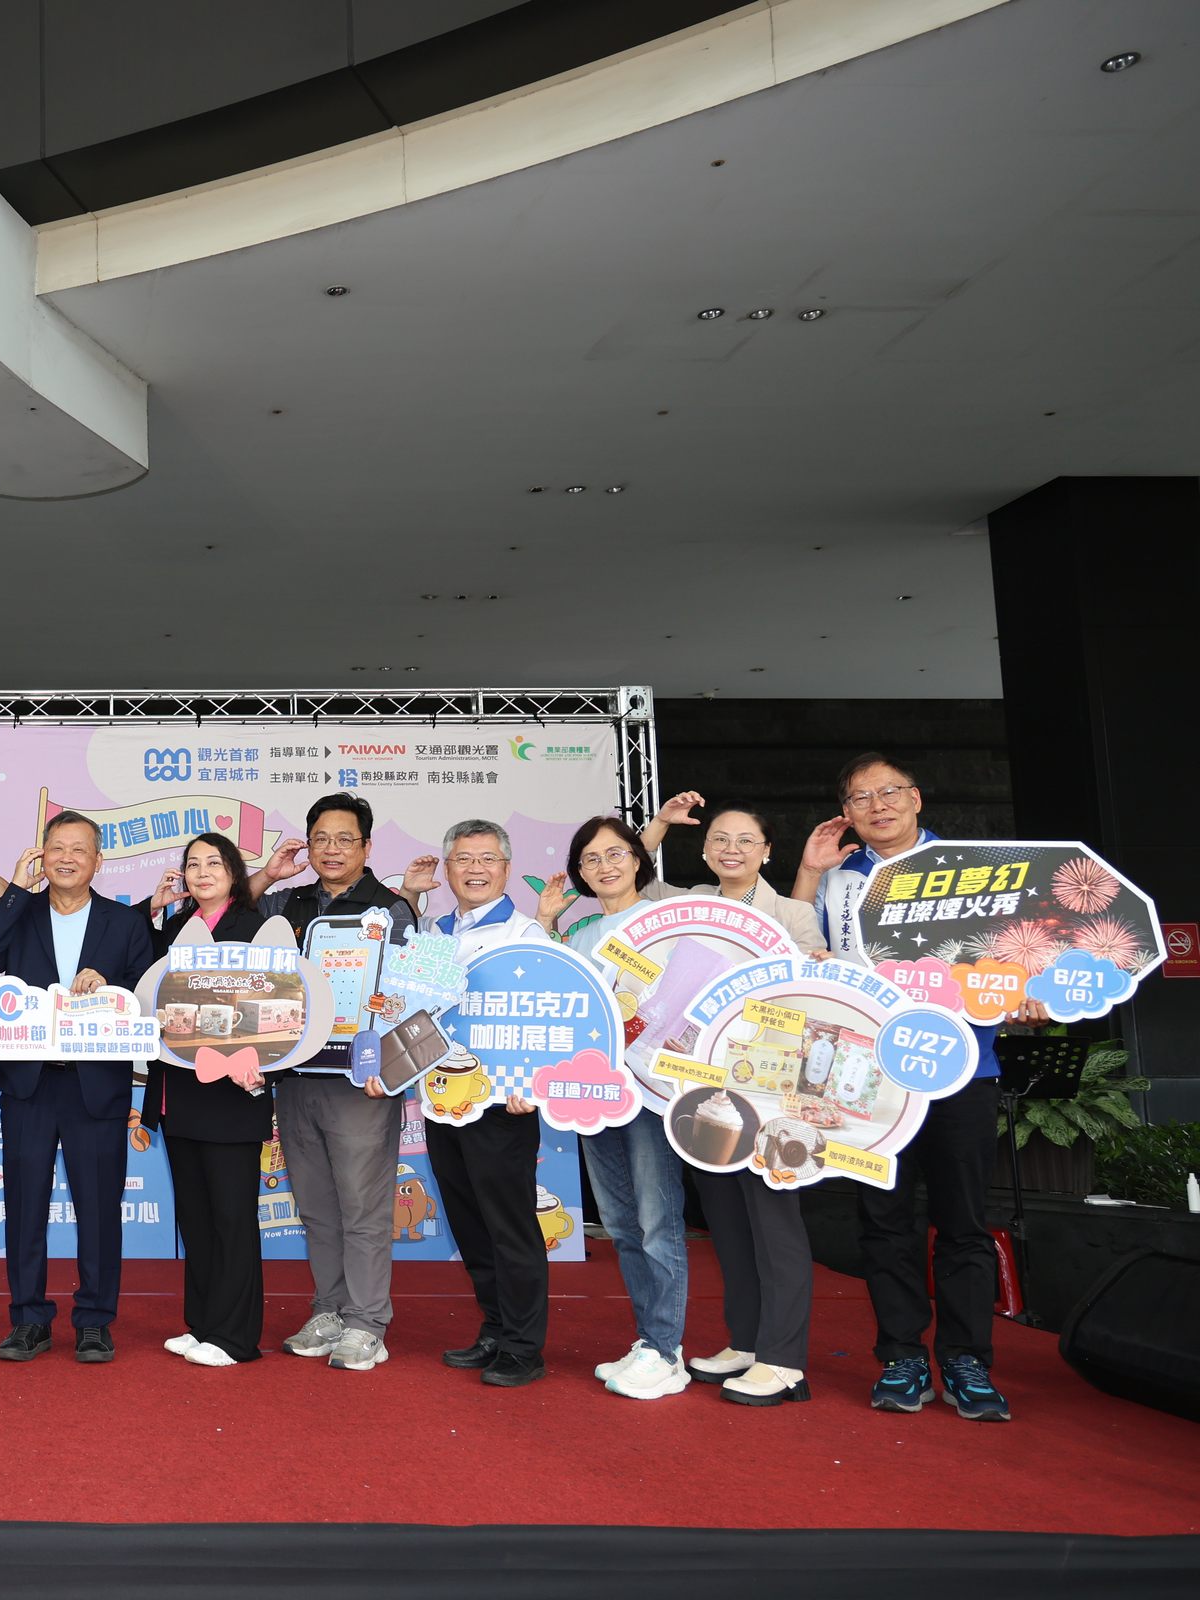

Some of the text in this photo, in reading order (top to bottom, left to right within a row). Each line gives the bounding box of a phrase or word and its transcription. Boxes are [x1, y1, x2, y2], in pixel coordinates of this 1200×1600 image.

[198, 748, 259, 762] 觀光首都
[270, 747, 318, 758] 指導單位
[338, 745, 406, 755] TAIWAN
[415, 745, 498, 755] 交通部觀光署
[198, 768, 259, 782] 宜居城市
[270, 772, 318, 783] 主辦單位
[361, 771, 418, 781] 南投縣政府
[427, 771, 498, 784] 南投縣議會
[140, 856, 166, 868] Now
[886, 862, 1031, 901] 夏日夢幻
[878, 893, 1020, 926] 璀璨煙火秀
[629, 906, 777, 947] 果然可口雙果味美式
[170, 946, 297, 971] 限定巧咖杯
[606, 943, 656, 980] 雙果美式SHAKE
[801, 961, 900, 1009] 永續主題日
[894, 969, 943, 988] 6/19
[967, 975, 1018, 991] 6/20
[1054, 970, 1104, 988] 6/21
[24, 996, 39, 1010] 投
[905, 988, 929, 1003] (五)
[979, 992, 1005, 1006] (六)
[1065, 988, 1093, 1004] (日)
[458, 991, 590, 1018] 精品巧克力
[751, 1004, 800, 1021] 大黑松小倆口
[761, 1015, 785, 1028] 野餐包
[60, 1023, 97, 1036] 06.19
[116, 1023, 154, 1036] 06.28
[469, 1024, 575, 1052] 咖啡展售
[893, 1025, 958, 1057] 6/27
[61, 1042, 154, 1053] 福興溫泉遊客中心
[901, 1055, 939, 1079] (六)
[548, 1082, 621, 1101] 超過70家
[264, 1231, 282, 1239] Now
